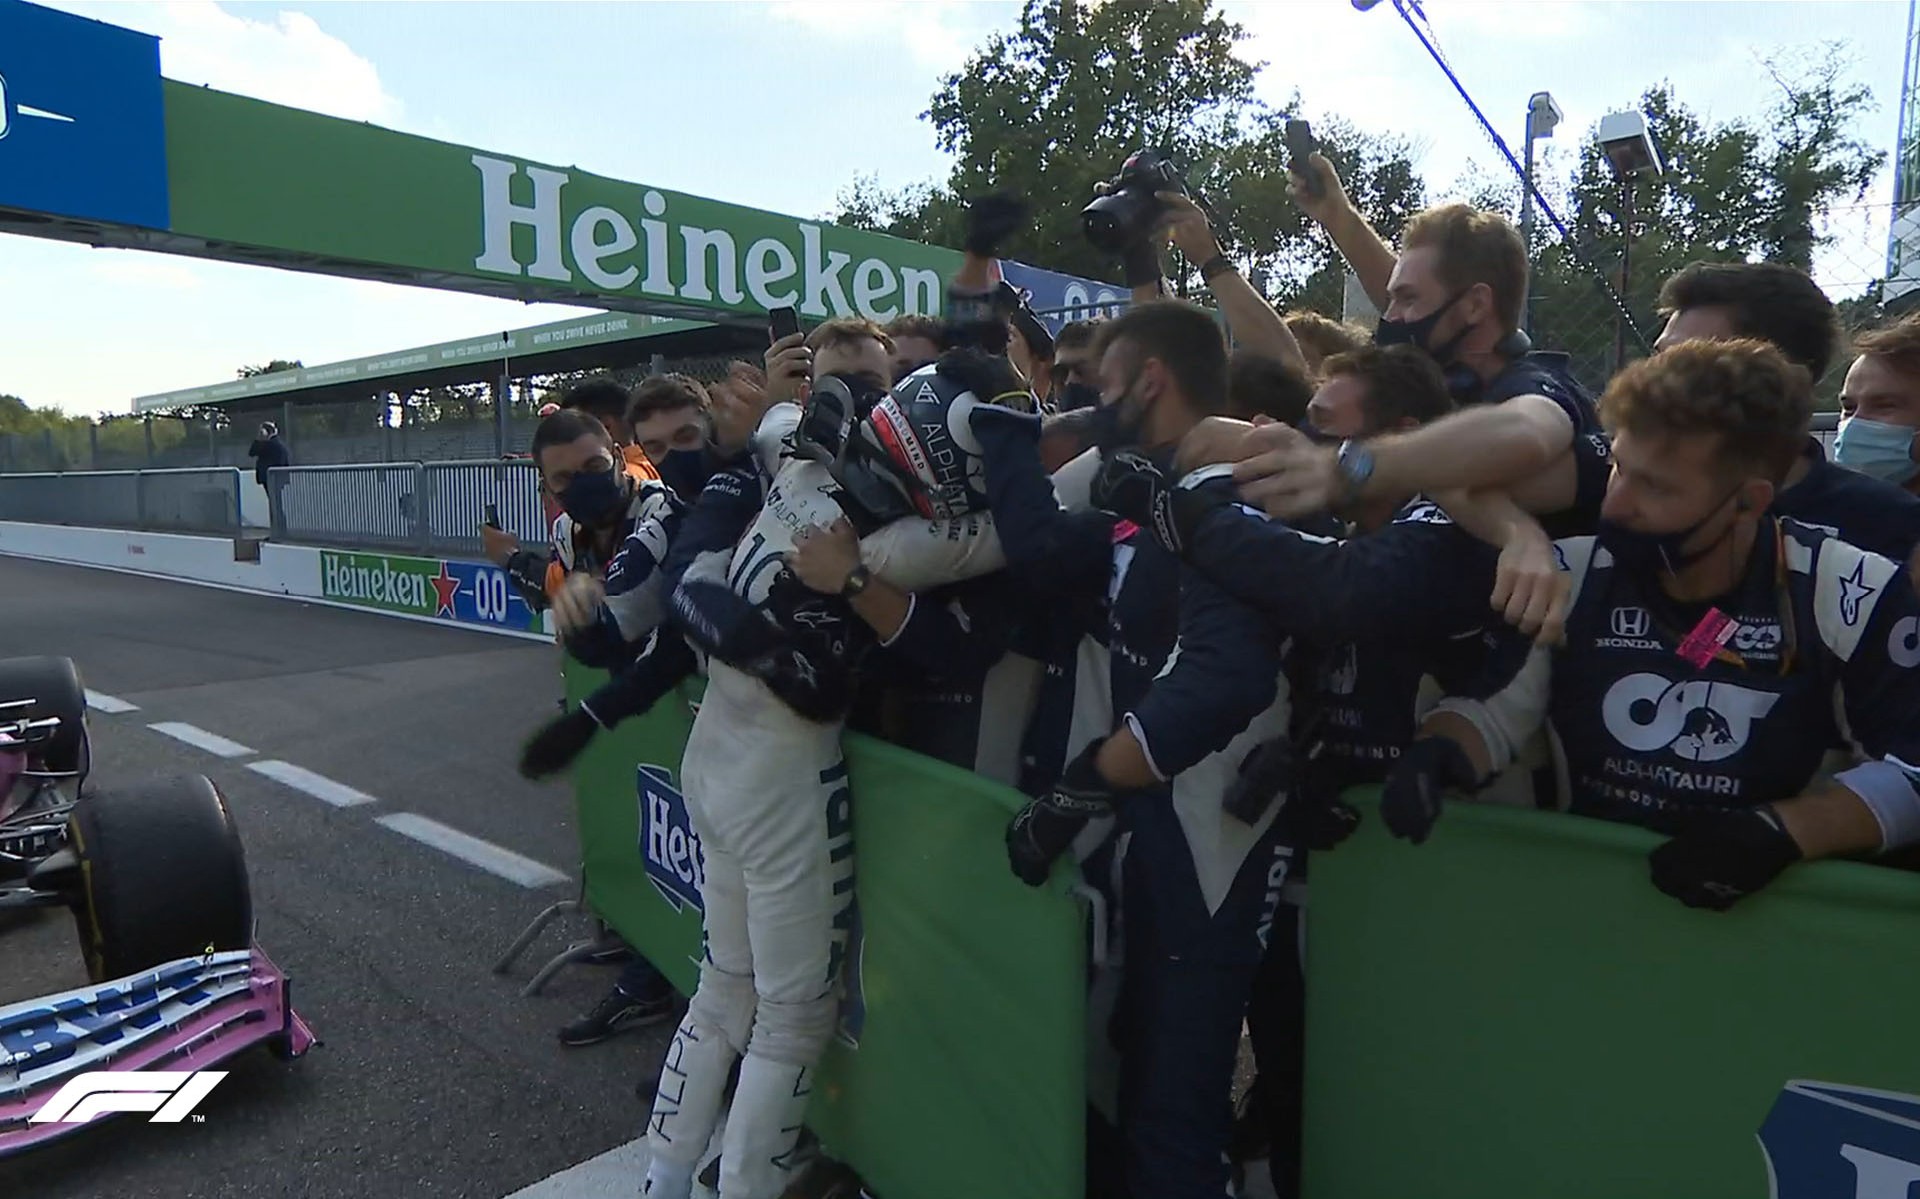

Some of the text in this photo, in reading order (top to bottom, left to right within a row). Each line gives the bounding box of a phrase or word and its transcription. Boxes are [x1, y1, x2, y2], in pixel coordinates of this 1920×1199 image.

[471, 154, 941, 324] Heineken
[552, 330, 564, 342] YOU
[566, 327, 584, 340] DRIVE
[585, 323, 606, 337] NEVER
[606, 318, 628, 333] DRINK
[324, 554, 428, 608] Heineken
[475, 569, 507, 623] 0.0
[1595, 637, 1664, 650] HONDA
[1603, 756, 1740, 796] ALPHATAURI
